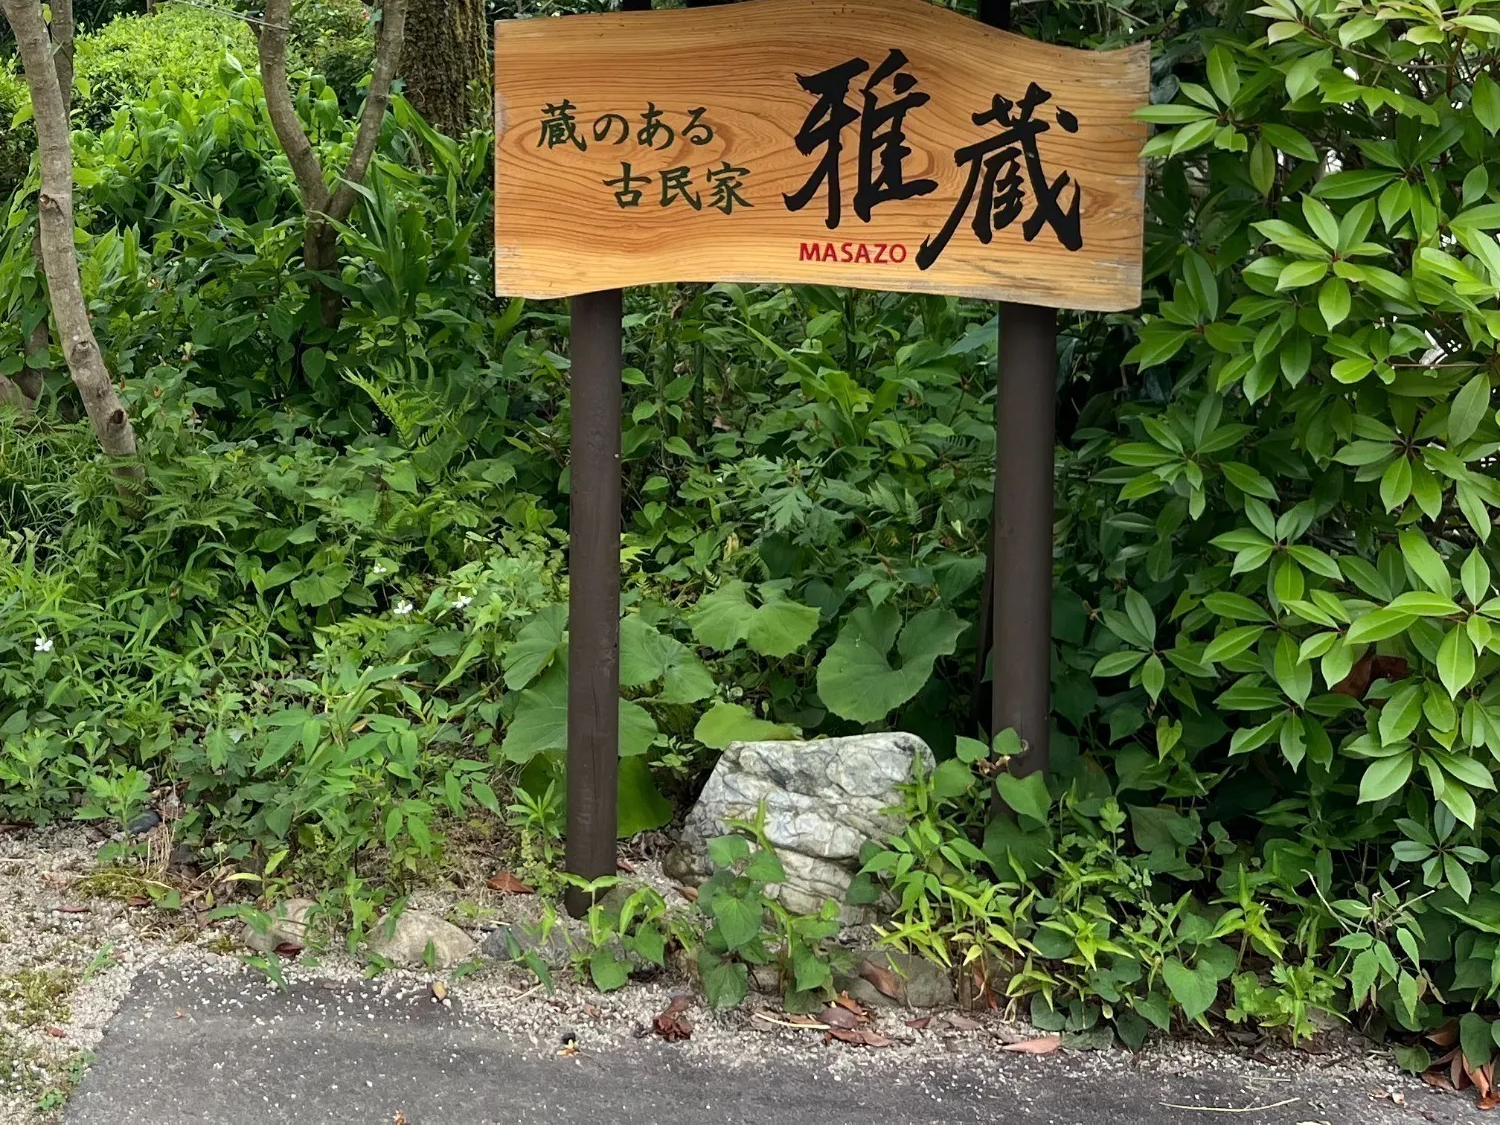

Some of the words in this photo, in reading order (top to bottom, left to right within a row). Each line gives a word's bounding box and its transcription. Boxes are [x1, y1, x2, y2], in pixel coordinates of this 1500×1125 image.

[536, 98, 715, 153] 蔵のある
[782, 48, 1083, 271] 雅蔵
[602, 161, 755, 216] 古民家
[799, 242, 907, 264] MASAZO
